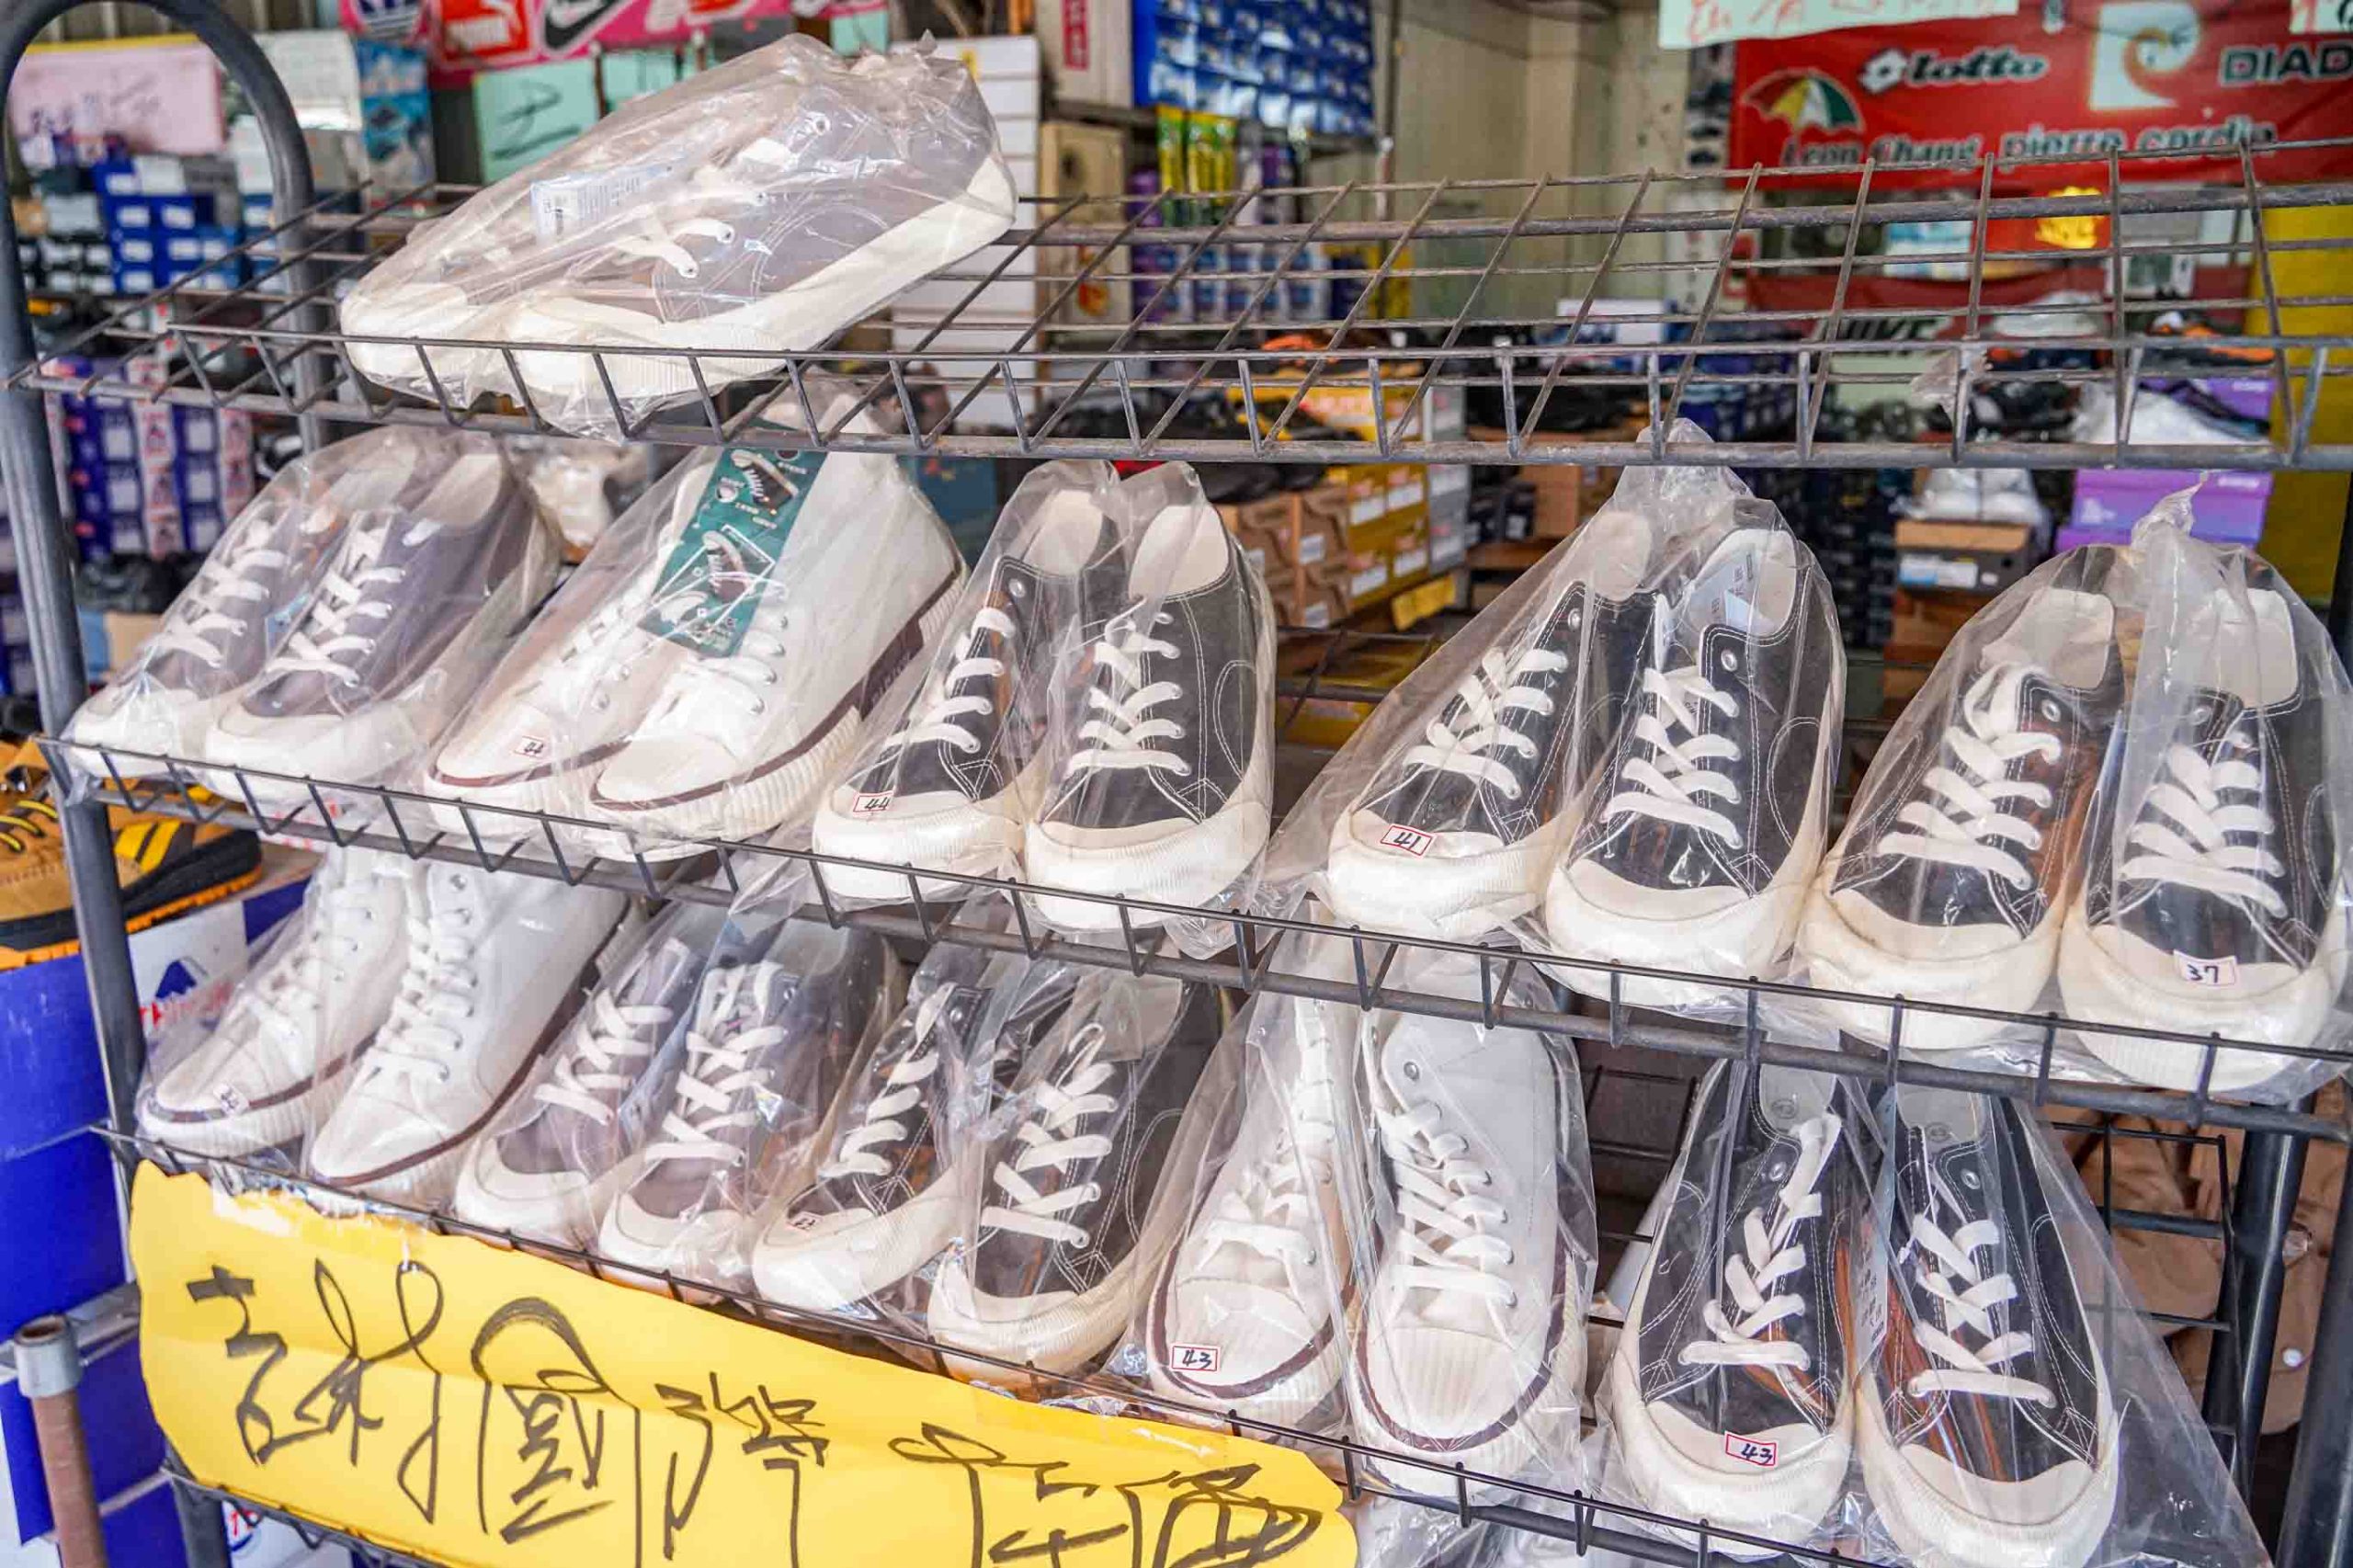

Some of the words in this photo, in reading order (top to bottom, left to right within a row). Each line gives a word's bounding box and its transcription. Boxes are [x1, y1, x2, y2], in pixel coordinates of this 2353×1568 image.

[1909, 51, 2048, 85] lotto
[1392, 831, 1422, 849] 41
[2187, 963, 2220, 984] 37
[1182, 1348, 1213, 1370] 43
[1740, 1442, 1774, 1465] 43
